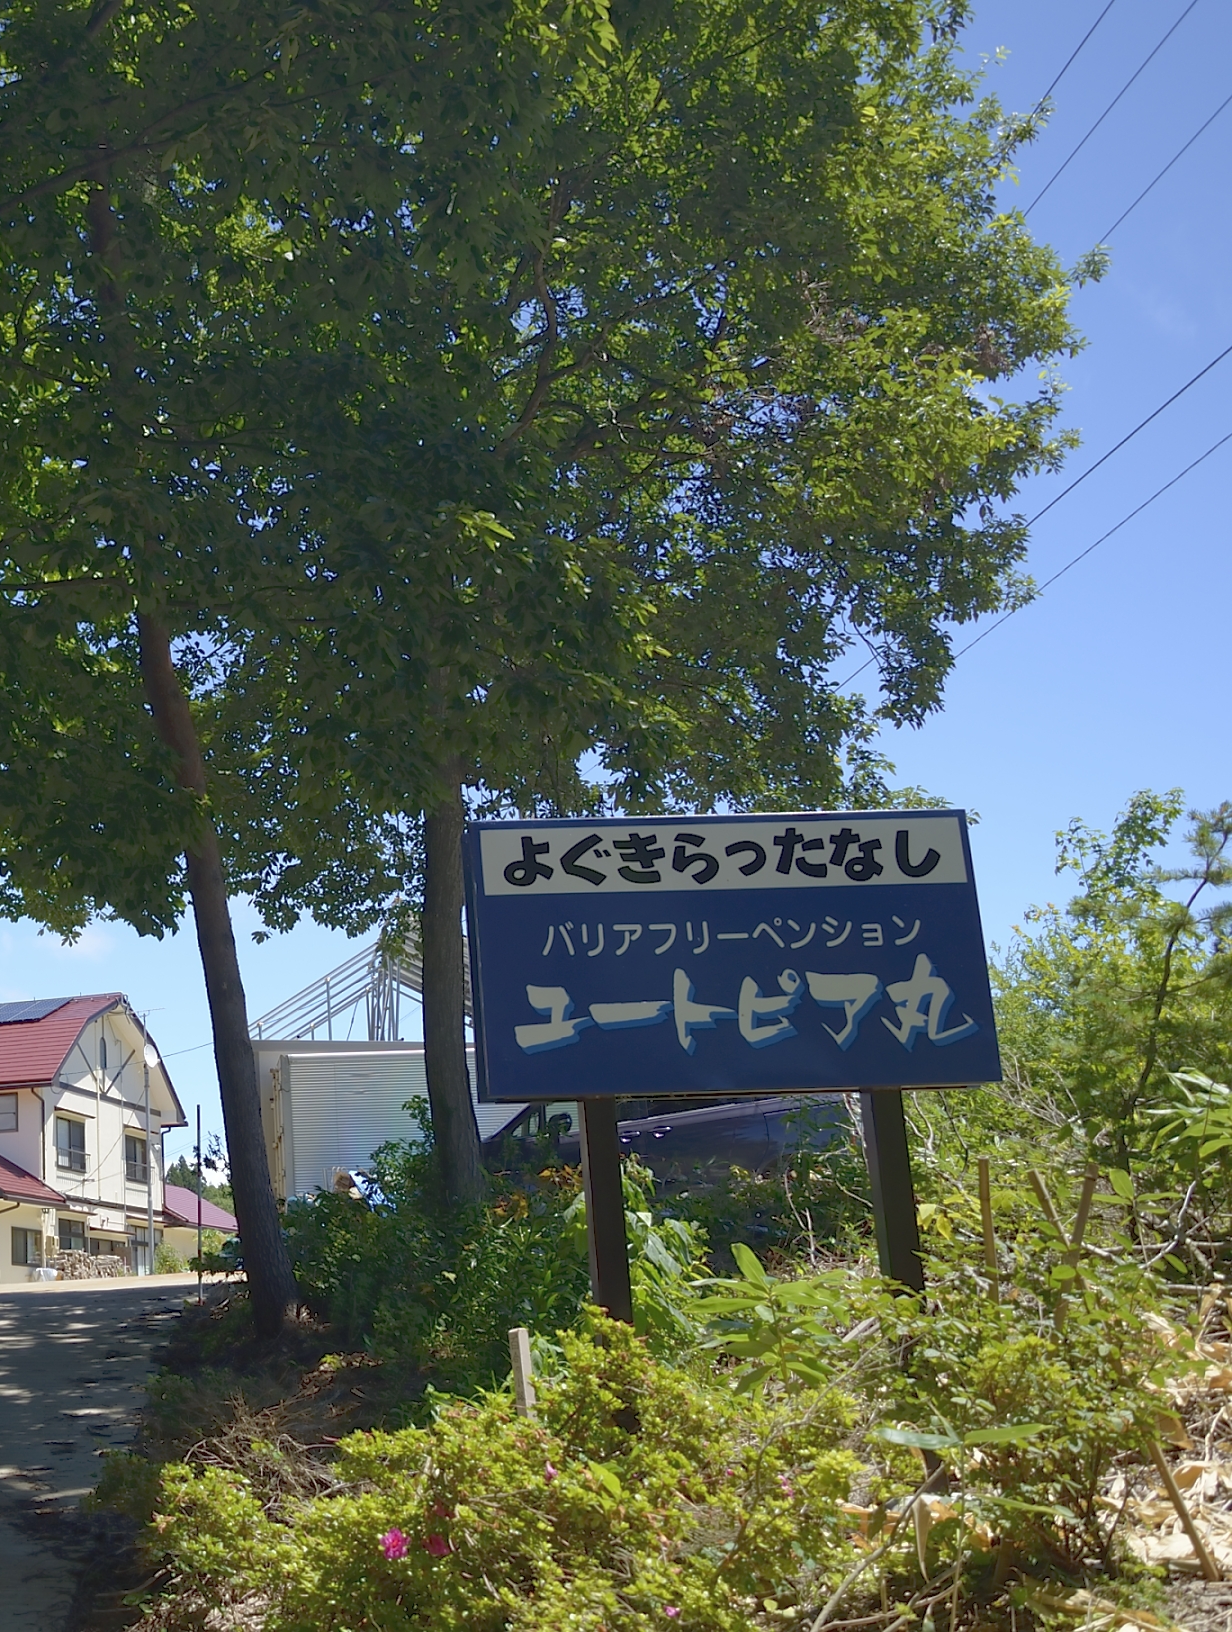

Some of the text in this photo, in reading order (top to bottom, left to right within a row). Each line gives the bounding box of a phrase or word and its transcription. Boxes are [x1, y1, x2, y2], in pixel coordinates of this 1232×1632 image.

[503, 828, 941, 887] よぐきらったなし
[542, 916, 921, 957] バリアフリーペンション
[514, 953, 978, 1055] ユートピア丸
